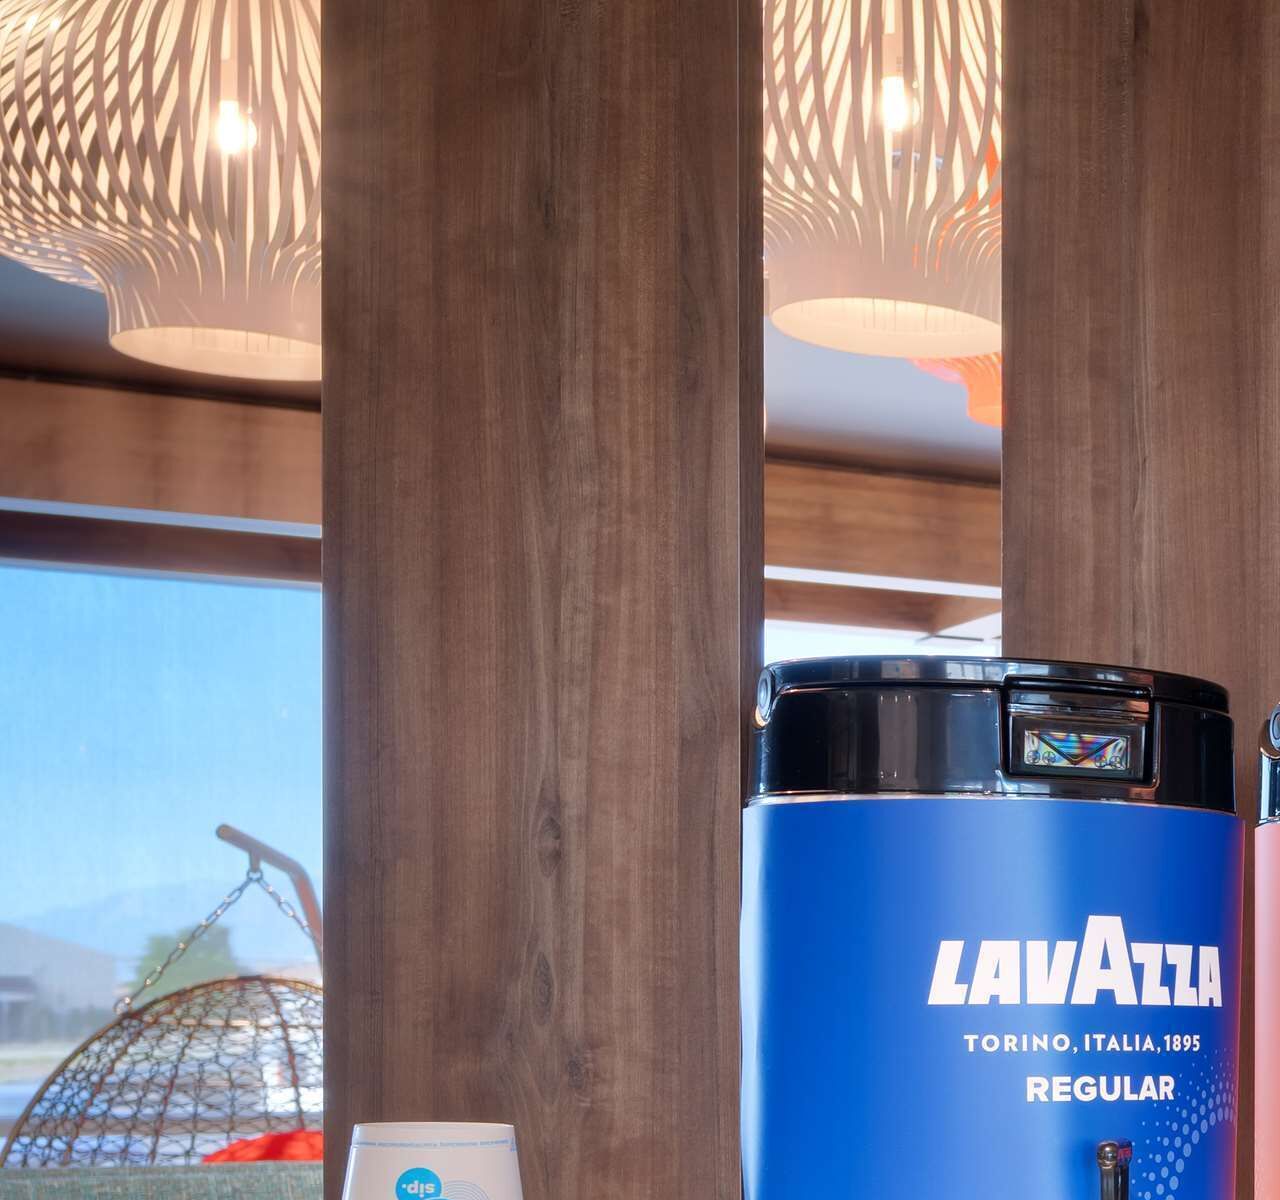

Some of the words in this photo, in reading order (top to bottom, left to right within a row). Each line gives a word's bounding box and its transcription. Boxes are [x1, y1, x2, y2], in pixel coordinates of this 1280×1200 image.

[928, 915, 1222, 1007] LAVAZZA
[964, 1034, 1078, 1055] TORINO,
[1084, 1034, 1161, 1054] ITALIA,
[1163, 1034, 1201, 1052] 1895
[1026, 1076, 1174, 1102] REGULAR
[402, 1180, 436, 1198] sip.
